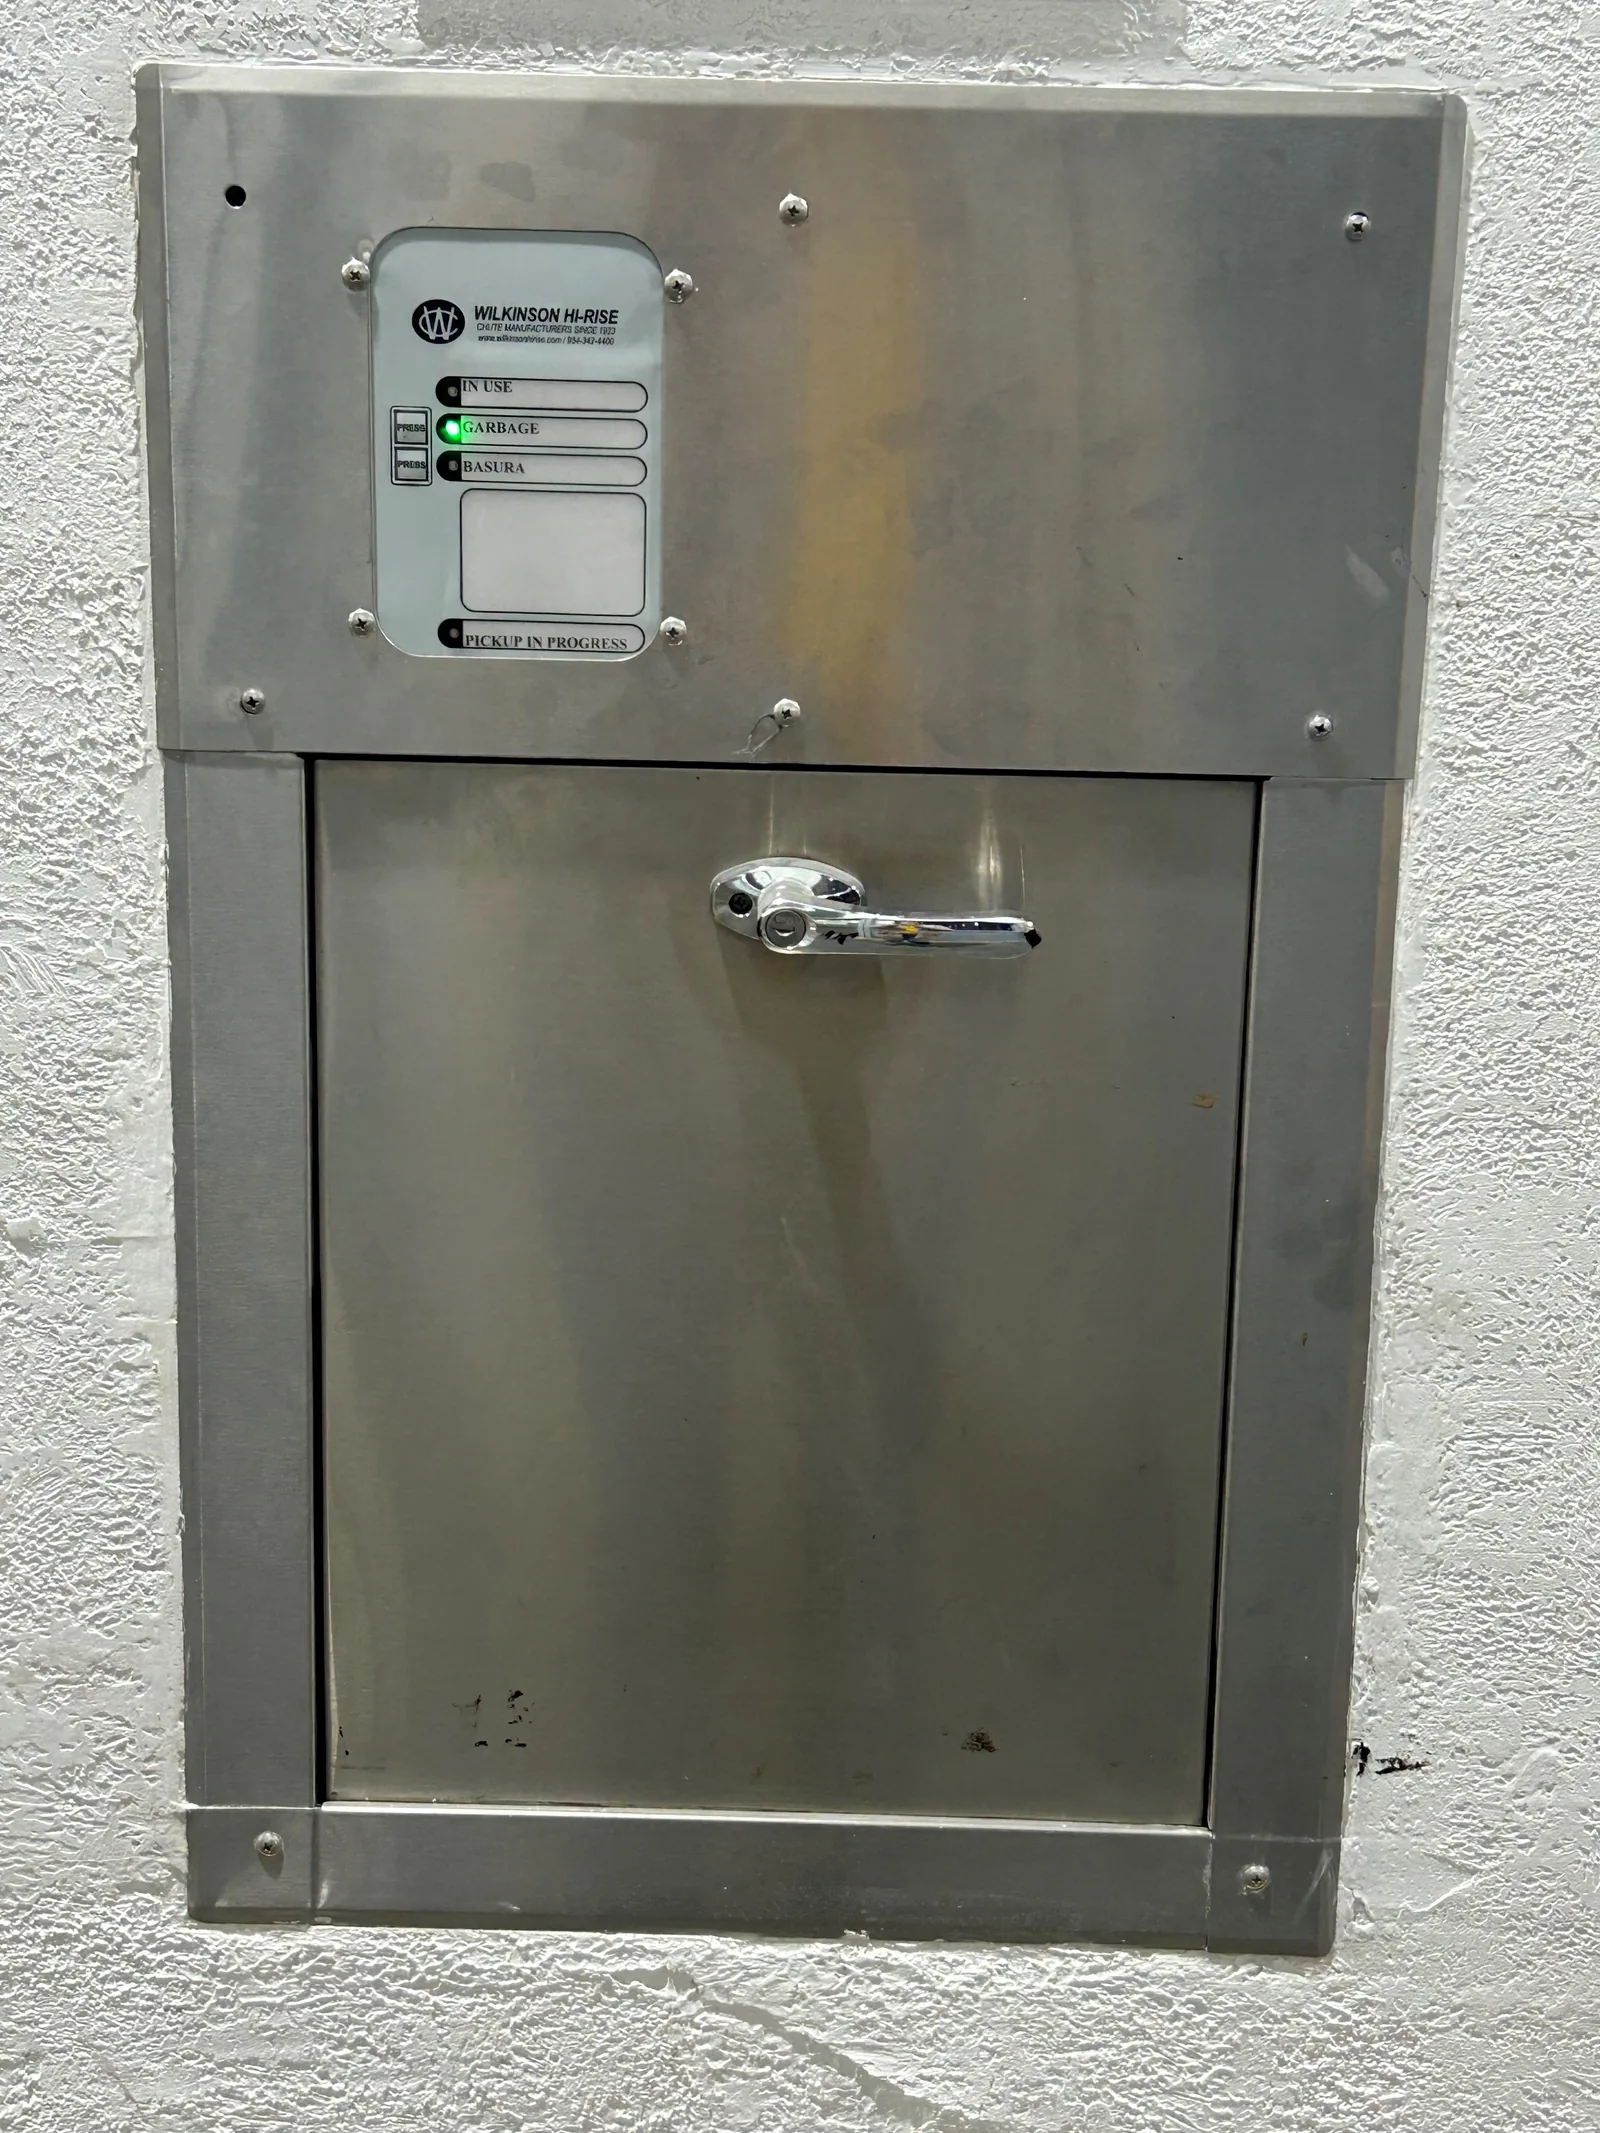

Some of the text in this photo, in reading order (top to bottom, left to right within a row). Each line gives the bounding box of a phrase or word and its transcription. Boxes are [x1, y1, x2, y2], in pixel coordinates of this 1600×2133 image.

[474, 305, 619, 325] WILKINSON HI-RISE
[476, 322, 503, 332] CHUTE
[504, 323, 572, 334] MANUFACTURERS
[574, 325, 598, 335] SINCE
[462, 379, 513, 393] IN USE
[396, 423, 426, 432] PRESS
[463, 421, 540, 435] GARBAGE
[396, 460, 427, 469] PRESS
[463, 460, 526, 475] BASURA
[465, 634, 628, 650] PICKUP IN PROGRESS
